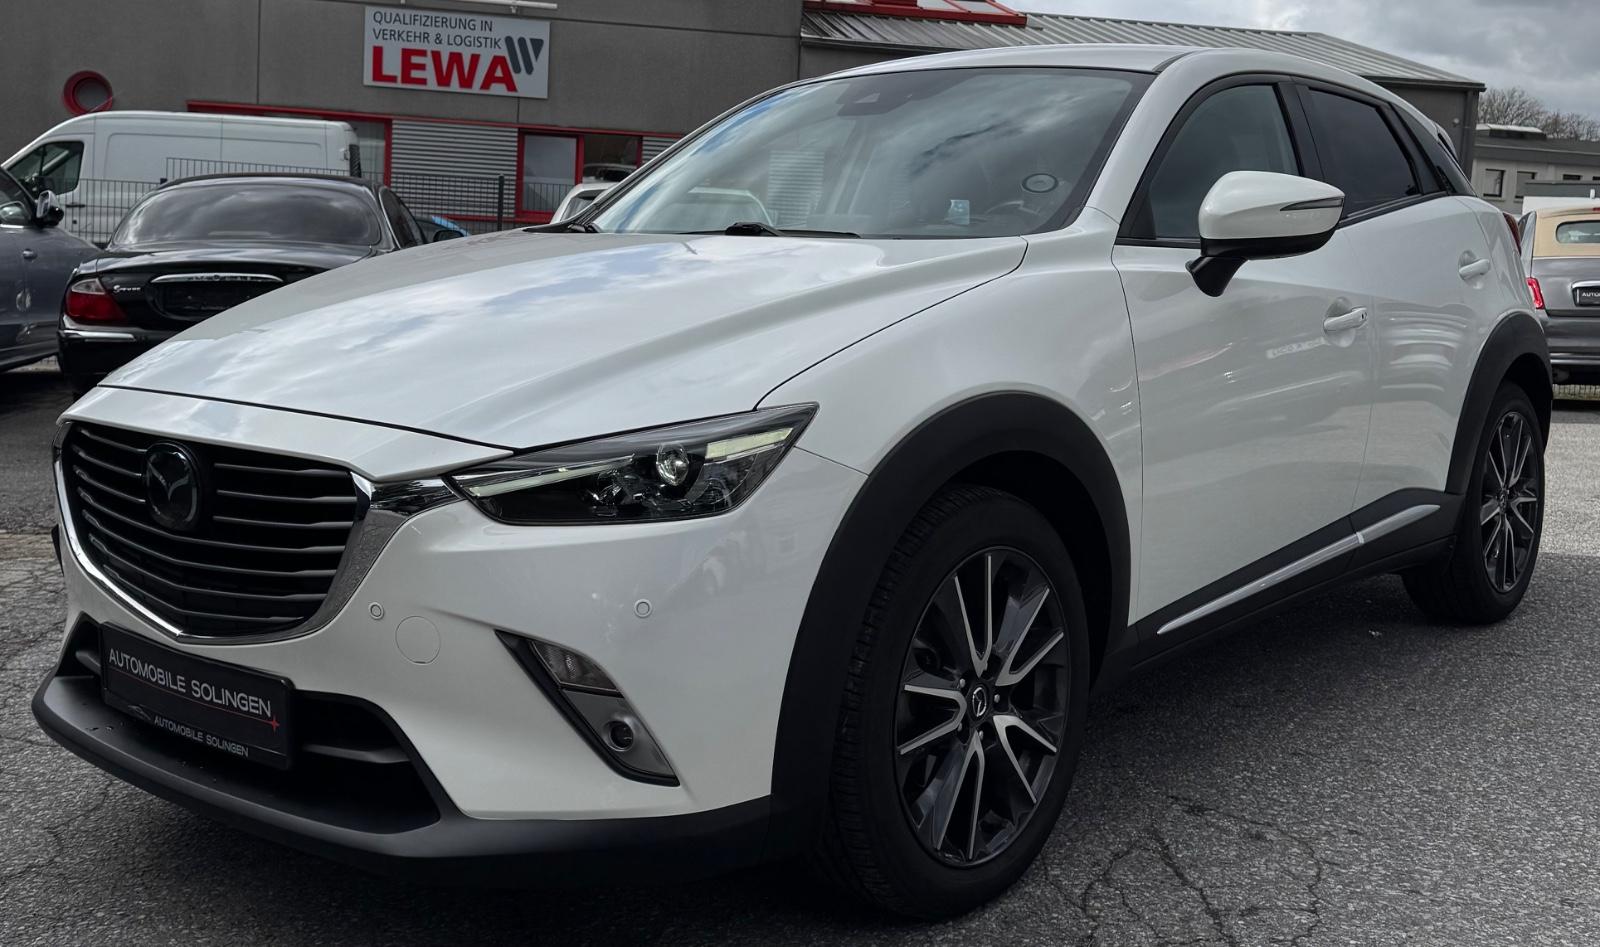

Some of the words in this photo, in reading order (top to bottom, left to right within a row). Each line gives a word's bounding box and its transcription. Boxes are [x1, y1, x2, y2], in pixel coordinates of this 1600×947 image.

[372, 10, 477, 32] QUALIFIZIERUNG
[480, 19, 493, 32] IN
[372, 28, 431, 44] VERKEHR
[434, 33, 443, 45] &
[447, 34, 502, 50] LOGISTIK
[372, 45, 518, 93] LEWA
[109, 648, 187, 693] AUTOMOBILE
[190, 679, 272, 718] SOLINGEN
[154, 715, 204, 743] AUTOMOBILE
[206, 734, 249, 758] SOLINGEN
